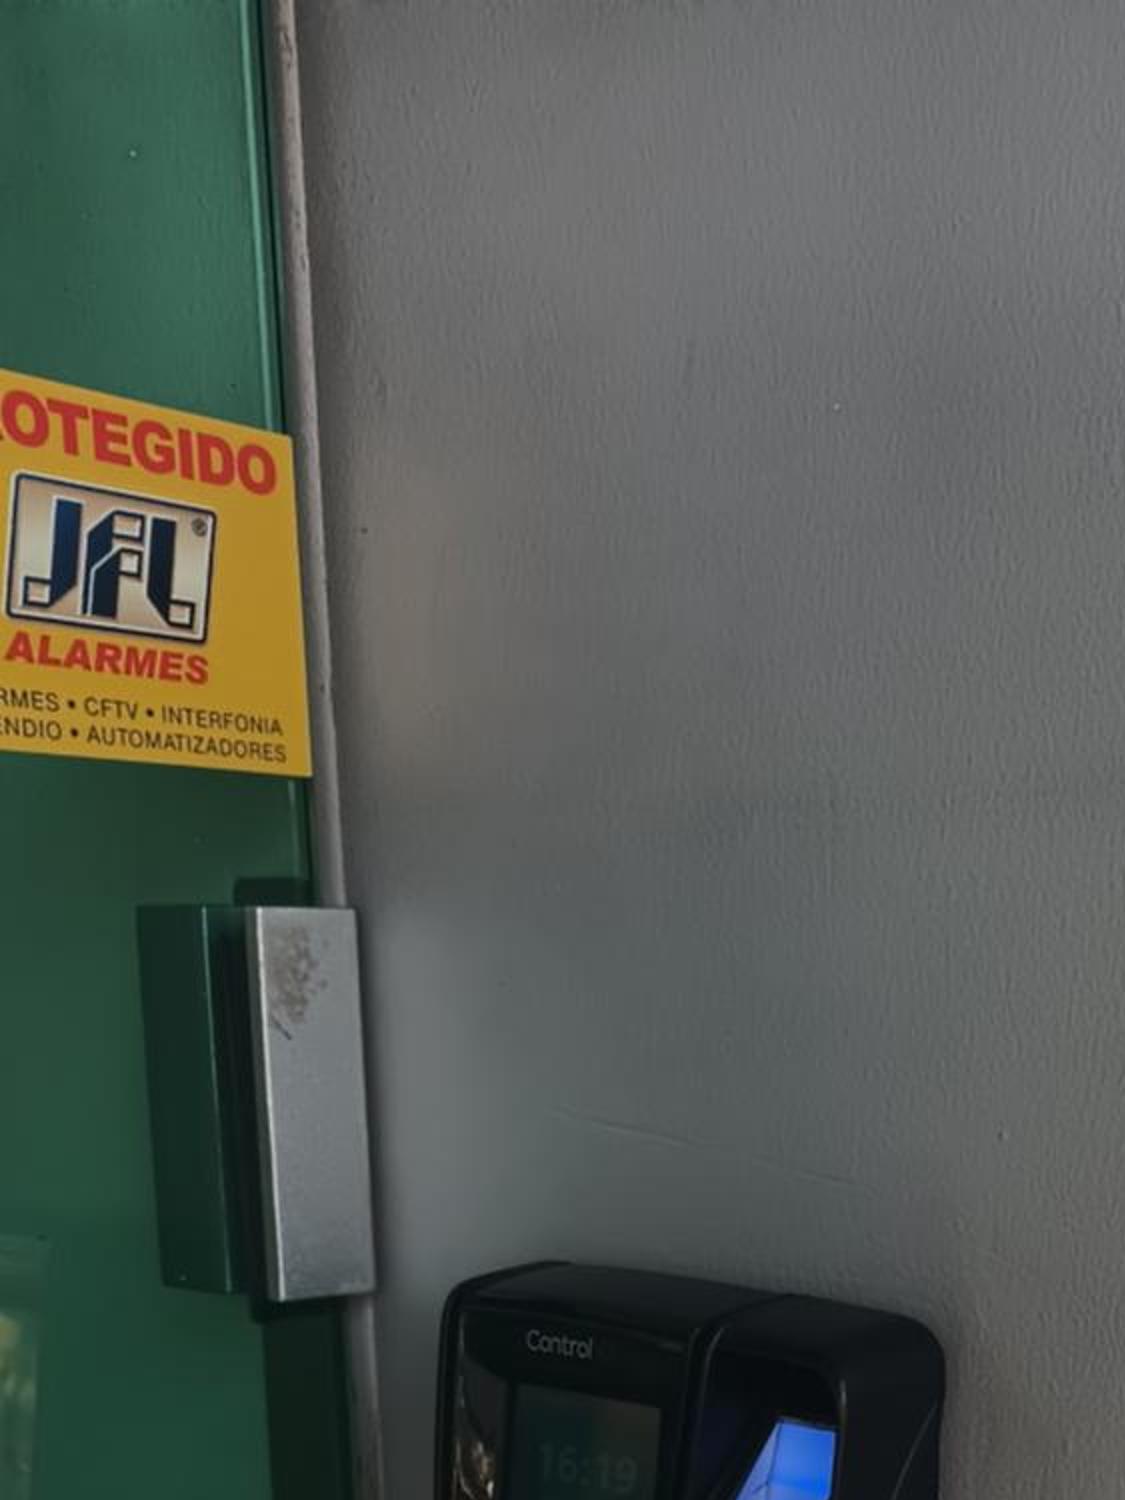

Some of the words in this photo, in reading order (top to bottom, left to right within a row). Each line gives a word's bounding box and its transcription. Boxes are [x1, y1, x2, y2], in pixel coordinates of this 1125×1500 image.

[0, 389, 278, 495] OTEGIDO
[22, 497, 197, 630] JFL
[4, 630, 209, 685] ALARMES
[0, 716, 63, 741] NDIO
[86, 724, 288, 763] AUTOMATIZADORES
[83, 696, 138, 720] CFTV
[161, 703, 284, 736] INTERFONIA
[527, 1329, 593, 1359] Control
[539, 1440, 640, 1496] 16:19
